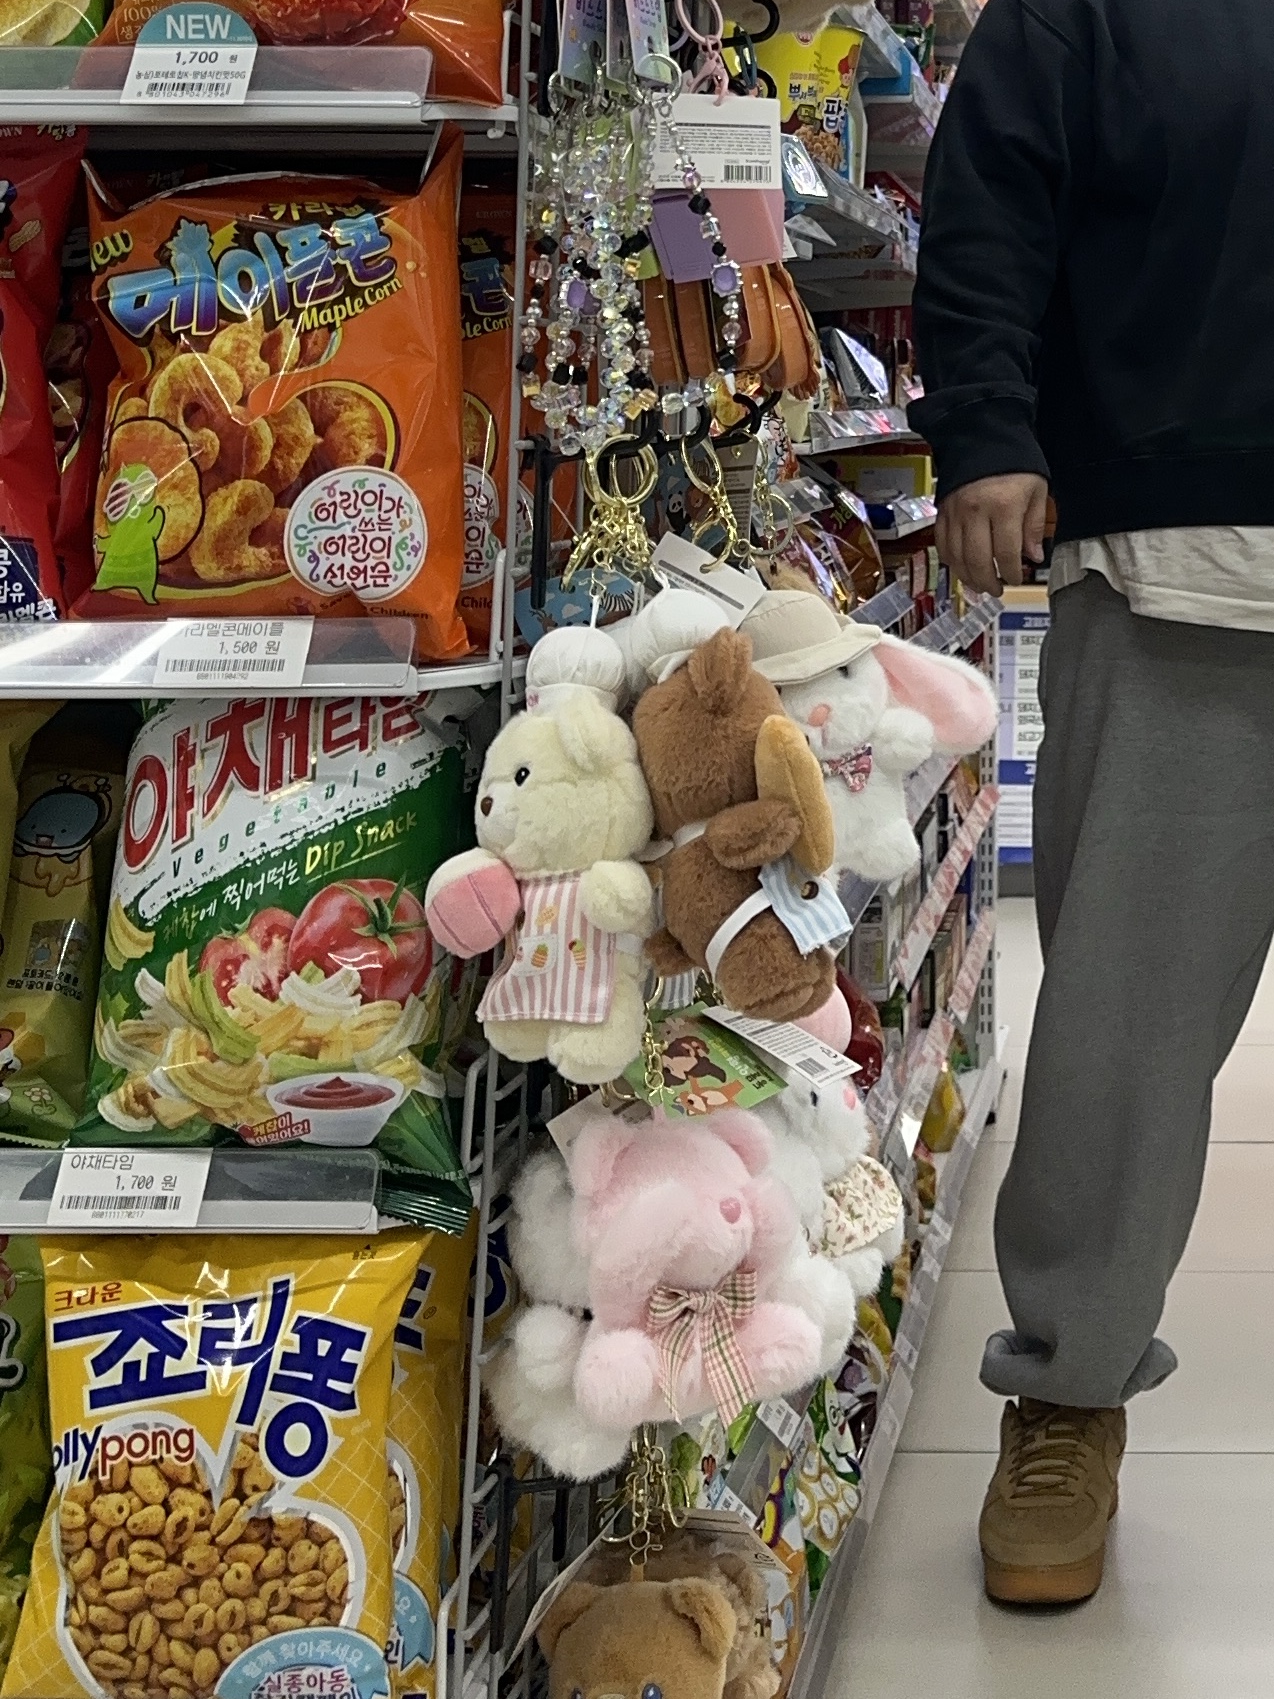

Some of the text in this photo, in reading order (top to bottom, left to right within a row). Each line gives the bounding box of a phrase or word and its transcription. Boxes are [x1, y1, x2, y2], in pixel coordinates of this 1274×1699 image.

[165, 14, 232, 41] NEW
[175, 51, 219, 65] 1,700
[89, 229, 134, 272] ew
[108, 211, 397, 340] 메이플콘
[300, 276, 403, 333] Maple Corn
[314, 483, 404, 525] 어린이가
[323, 533, 392, 562] 어린이
[323, 560, 394, 589] 선언문
[219, 639, 282, 656] 1,500 원
[303, 839, 343, 876] Dip
[353, 811, 418, 859] Snack
[70, 1154, 135, 1171] 야채타임
[115, 1174, 178, 1191] 1,700 원
[53, 1282, 123, 1312] 크라운
[51, 1274, 372, 1478] 죠리퐁
[53, 1424, 196, 1483] ollypong
[262, 1667, 348, 1693] 실종아동
